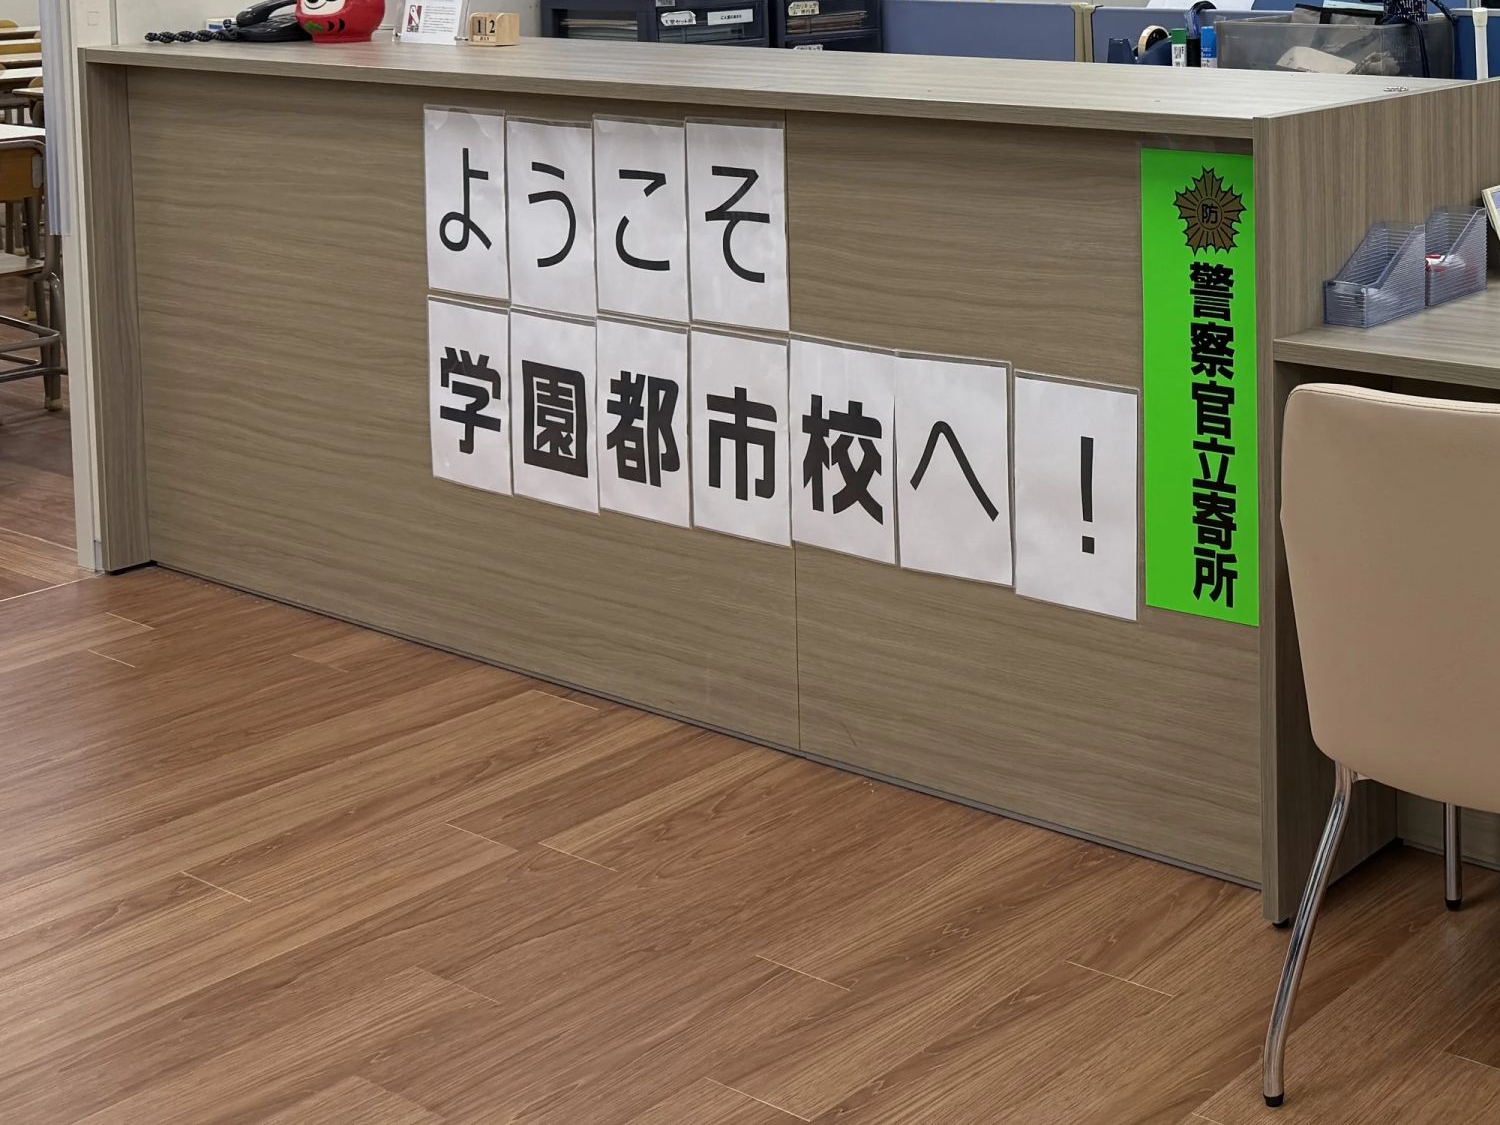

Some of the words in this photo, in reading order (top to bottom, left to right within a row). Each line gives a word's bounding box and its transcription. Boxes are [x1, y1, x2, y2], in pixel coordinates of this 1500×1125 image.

[439, 147, 770, 283] ようこそ
[1201, 203, 1218, 224] 防
[1188, 261, 1238, 608] 警察官立寄所
